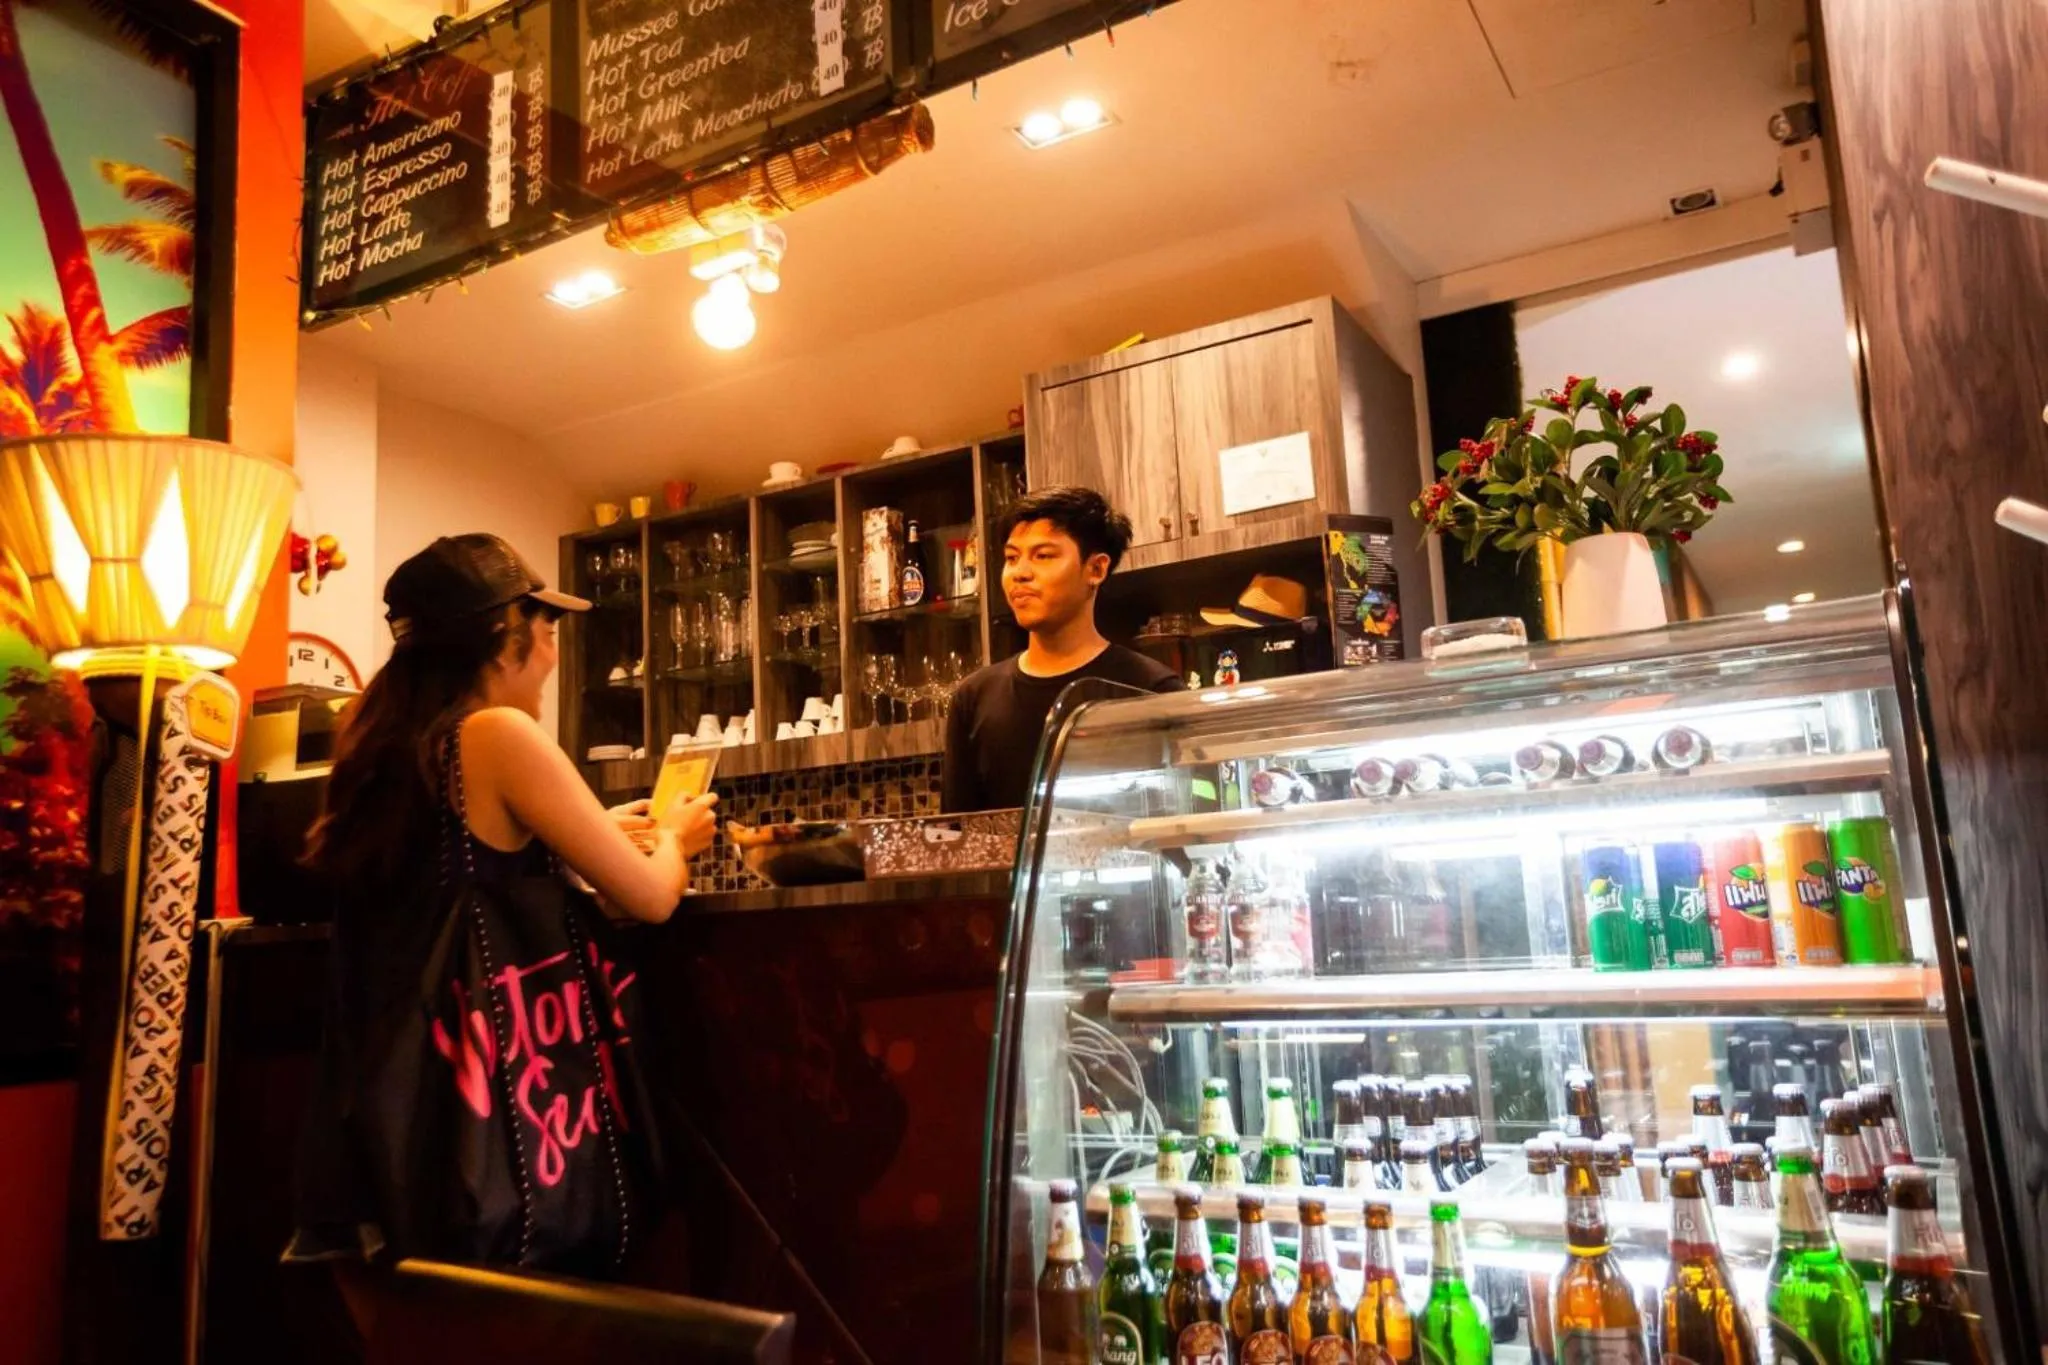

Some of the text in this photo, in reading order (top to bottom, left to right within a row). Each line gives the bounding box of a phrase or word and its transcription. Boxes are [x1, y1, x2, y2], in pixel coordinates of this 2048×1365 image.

[943, 0, 989, 33] Ice
[586, 36, 685, 95] Hot Tea
[586, 112, 633, 153] Hot
[638, 91, 692, 132] Milk
[820, 30, 838, 46] 40
[586, 82, 633, 122] Hot
[586, 150, 626, 185] Hot
[823, 63, 839, 80] 40
[321, 176, 359, 211] Hot
[362, 142, 452, 193] Espresso
[322, 150, 359, 185] Hot
[362, 111, 461, 167] Americano
[320, 201, 358, 236] Hot
[360, 161, 468, 217] Cappuccino
[318, 253, 356, 287] Hot
[358, 230, 424, 272] Mocha
[319, 227, 357, 261] Hot
[359, 207, 412, 245] Latte
[298, 648, 315, 661] 12
[325, 658, 330, 669] 1
[334, 675, 346, 687] 2
